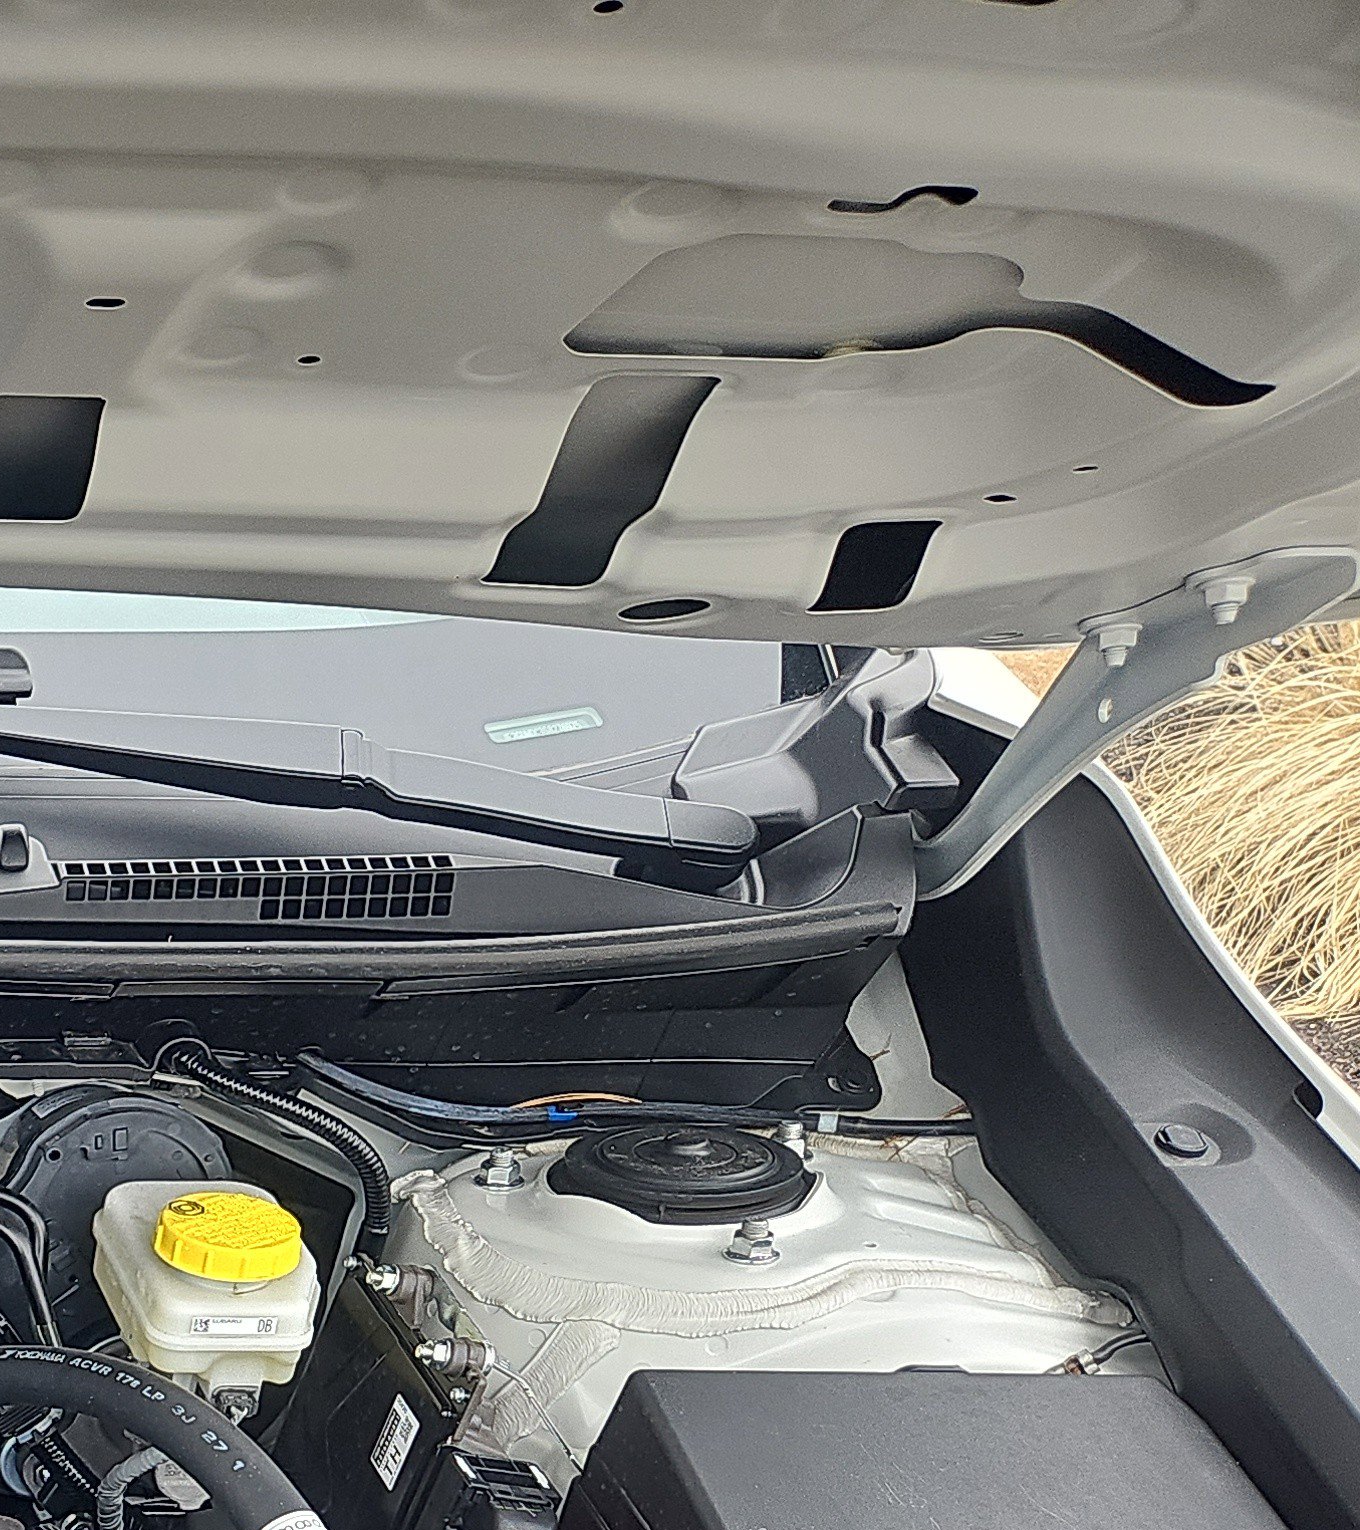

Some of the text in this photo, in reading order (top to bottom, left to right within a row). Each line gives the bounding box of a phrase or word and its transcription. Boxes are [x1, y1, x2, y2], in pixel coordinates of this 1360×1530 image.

[257, 1319, 273, 1333] DB
[69, 1357, 113, 1376] ACVR
[141, 1385, 166, 1402] LP
[171, 1404, 196, 1424] 3J
[201, 1429, 229, 1451] 27
